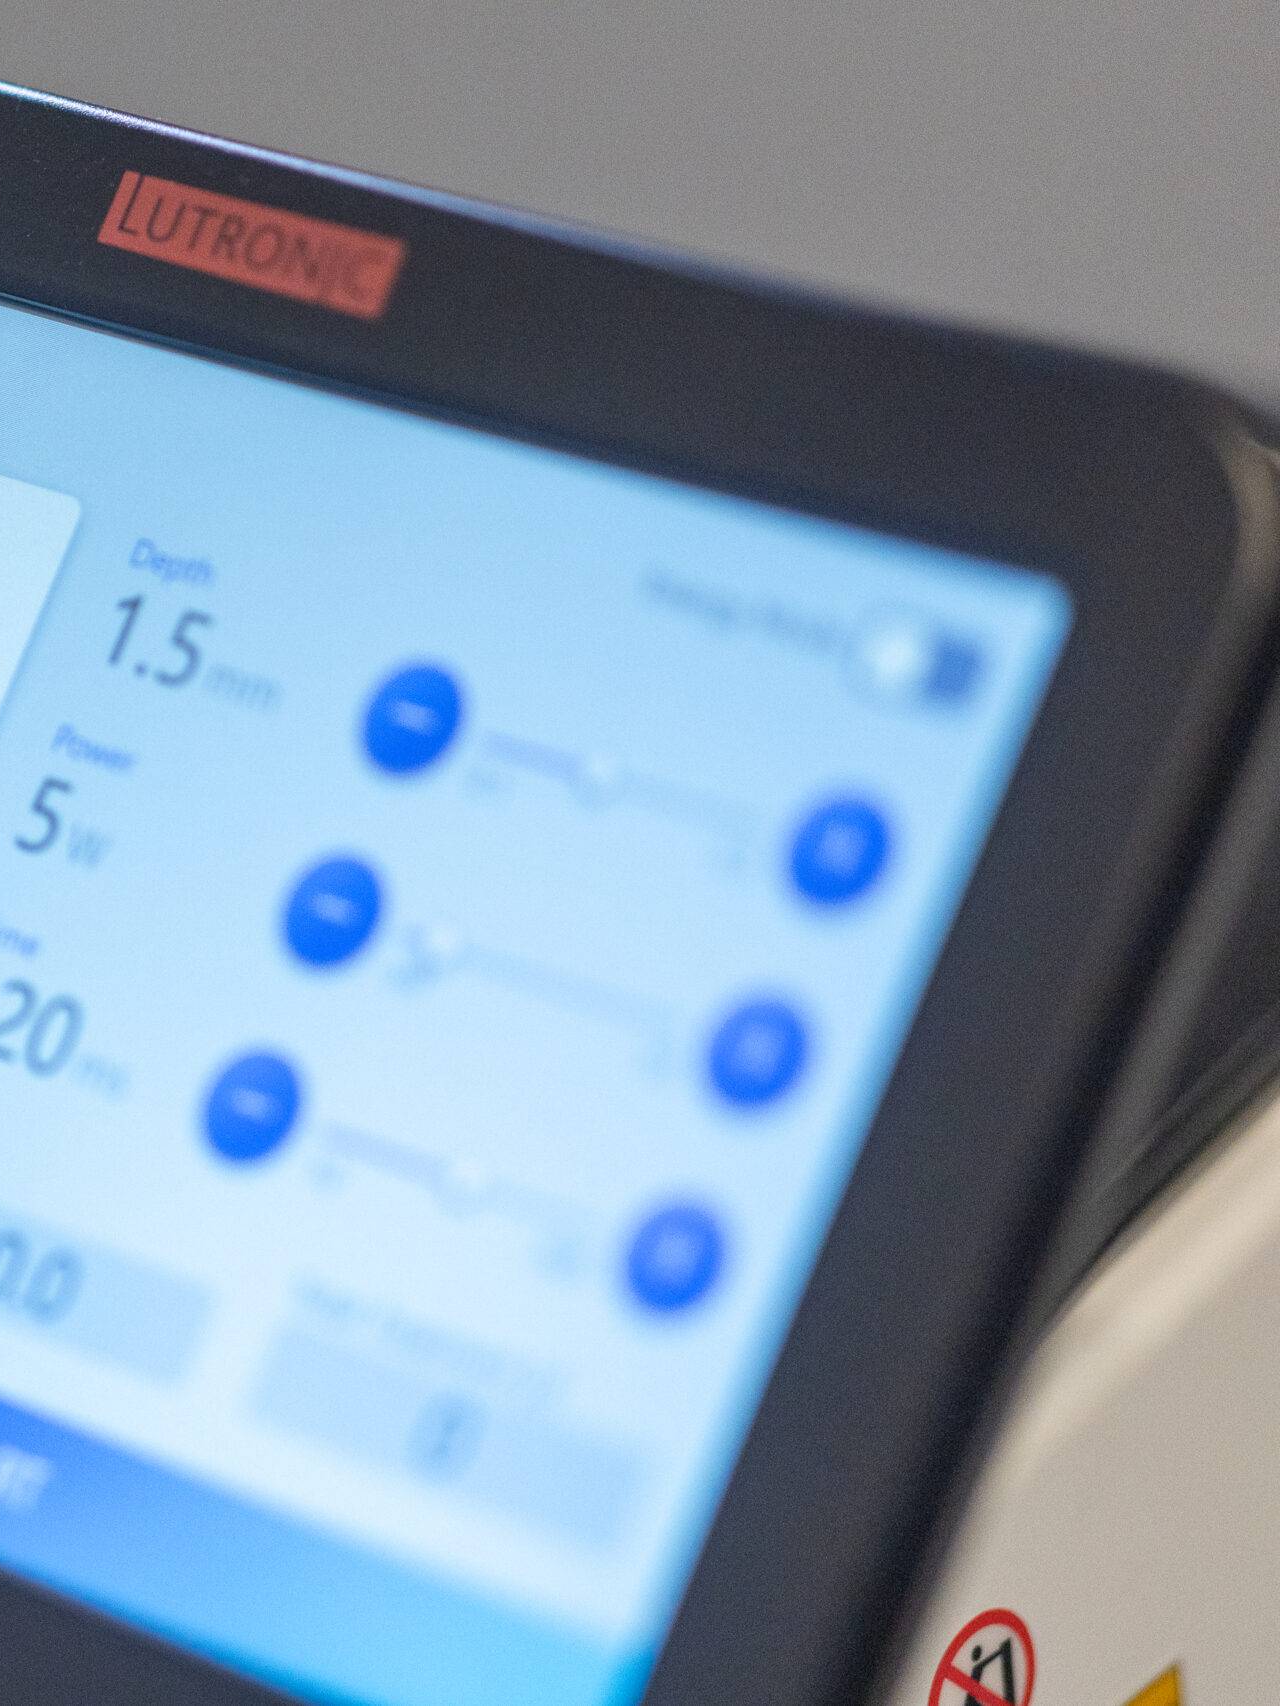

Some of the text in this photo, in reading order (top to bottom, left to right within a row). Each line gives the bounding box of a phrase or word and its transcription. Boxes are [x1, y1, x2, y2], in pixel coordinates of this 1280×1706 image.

[117, 173, 389, 303] LUTRONIC
[127, 536, 215, 588] Depth
[107, 594, 213, 690] 1.5
[51, 722, 138, 775] Power
[14, 775, 73, 855] 5
